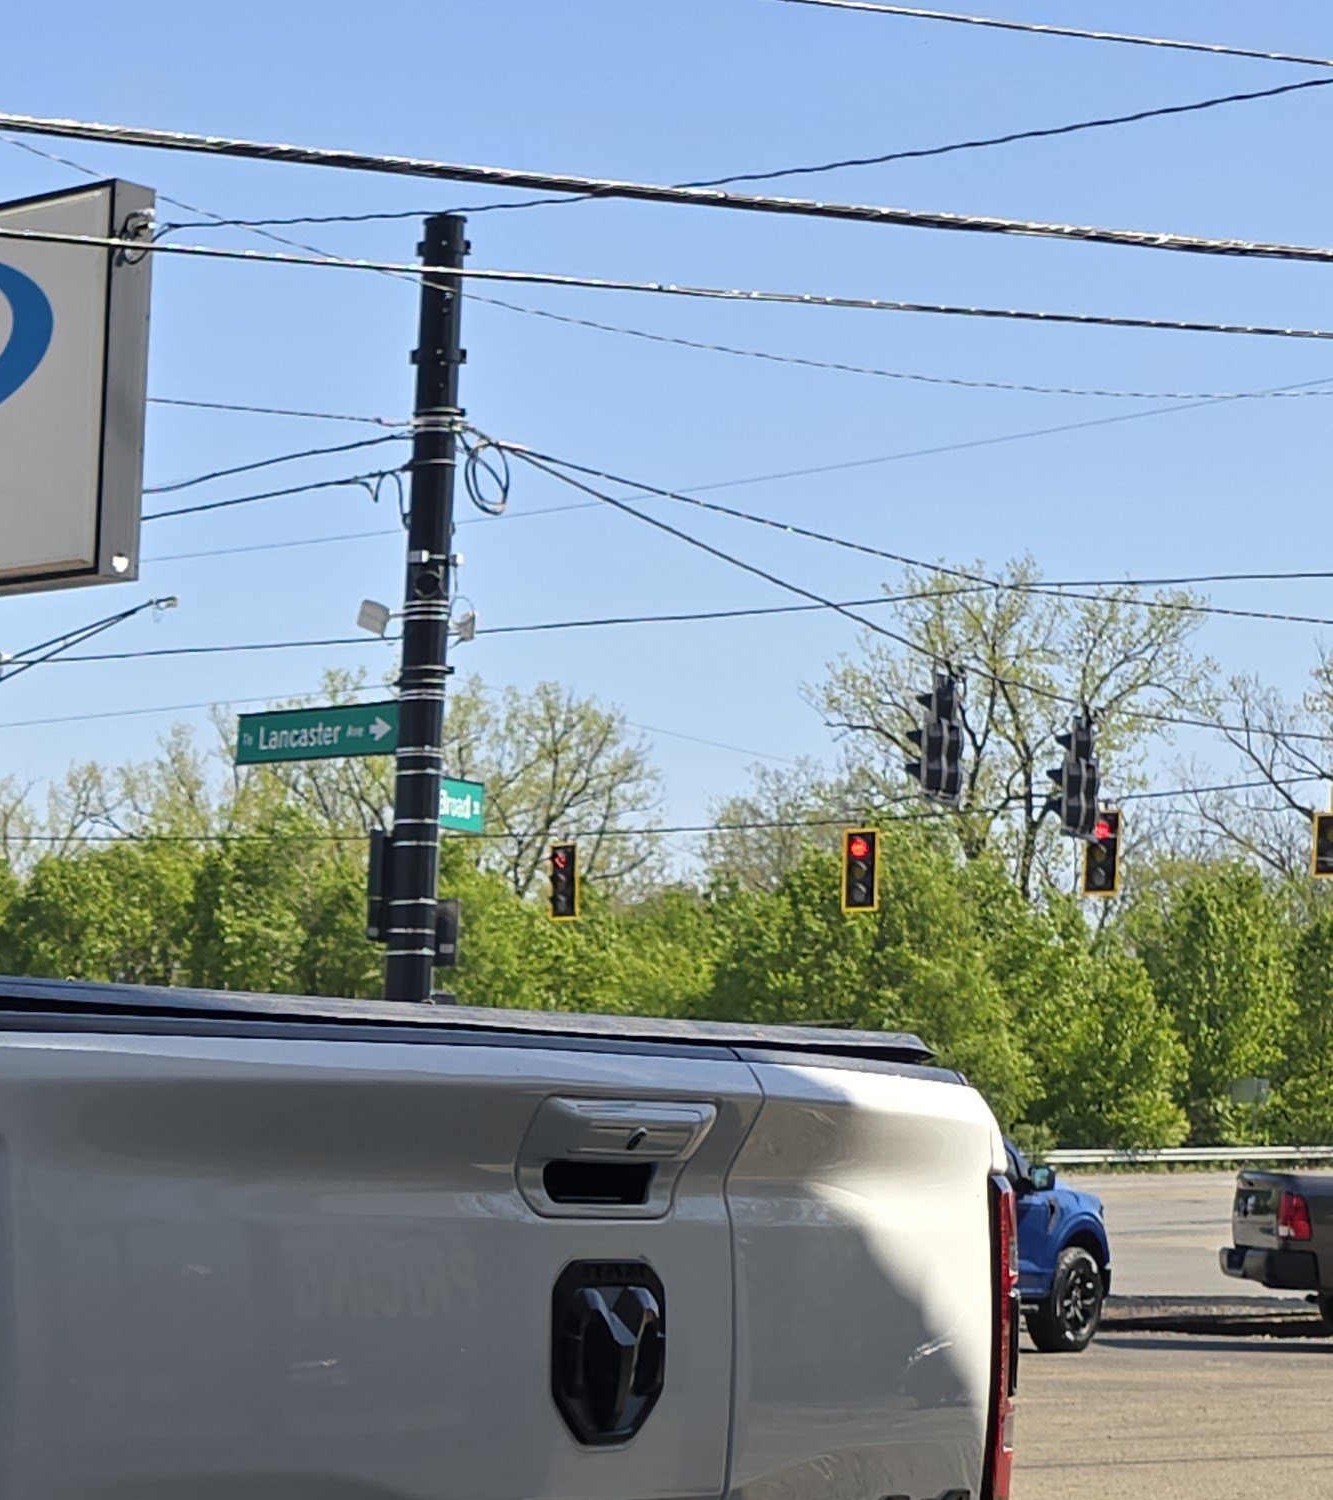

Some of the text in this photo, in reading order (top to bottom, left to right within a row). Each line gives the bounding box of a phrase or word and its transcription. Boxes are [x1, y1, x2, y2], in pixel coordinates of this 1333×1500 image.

[258, 721, 341, 750] Lancaster
[346, 724, 364, 738] Ave
[439, 788, 471, 819] Broad
